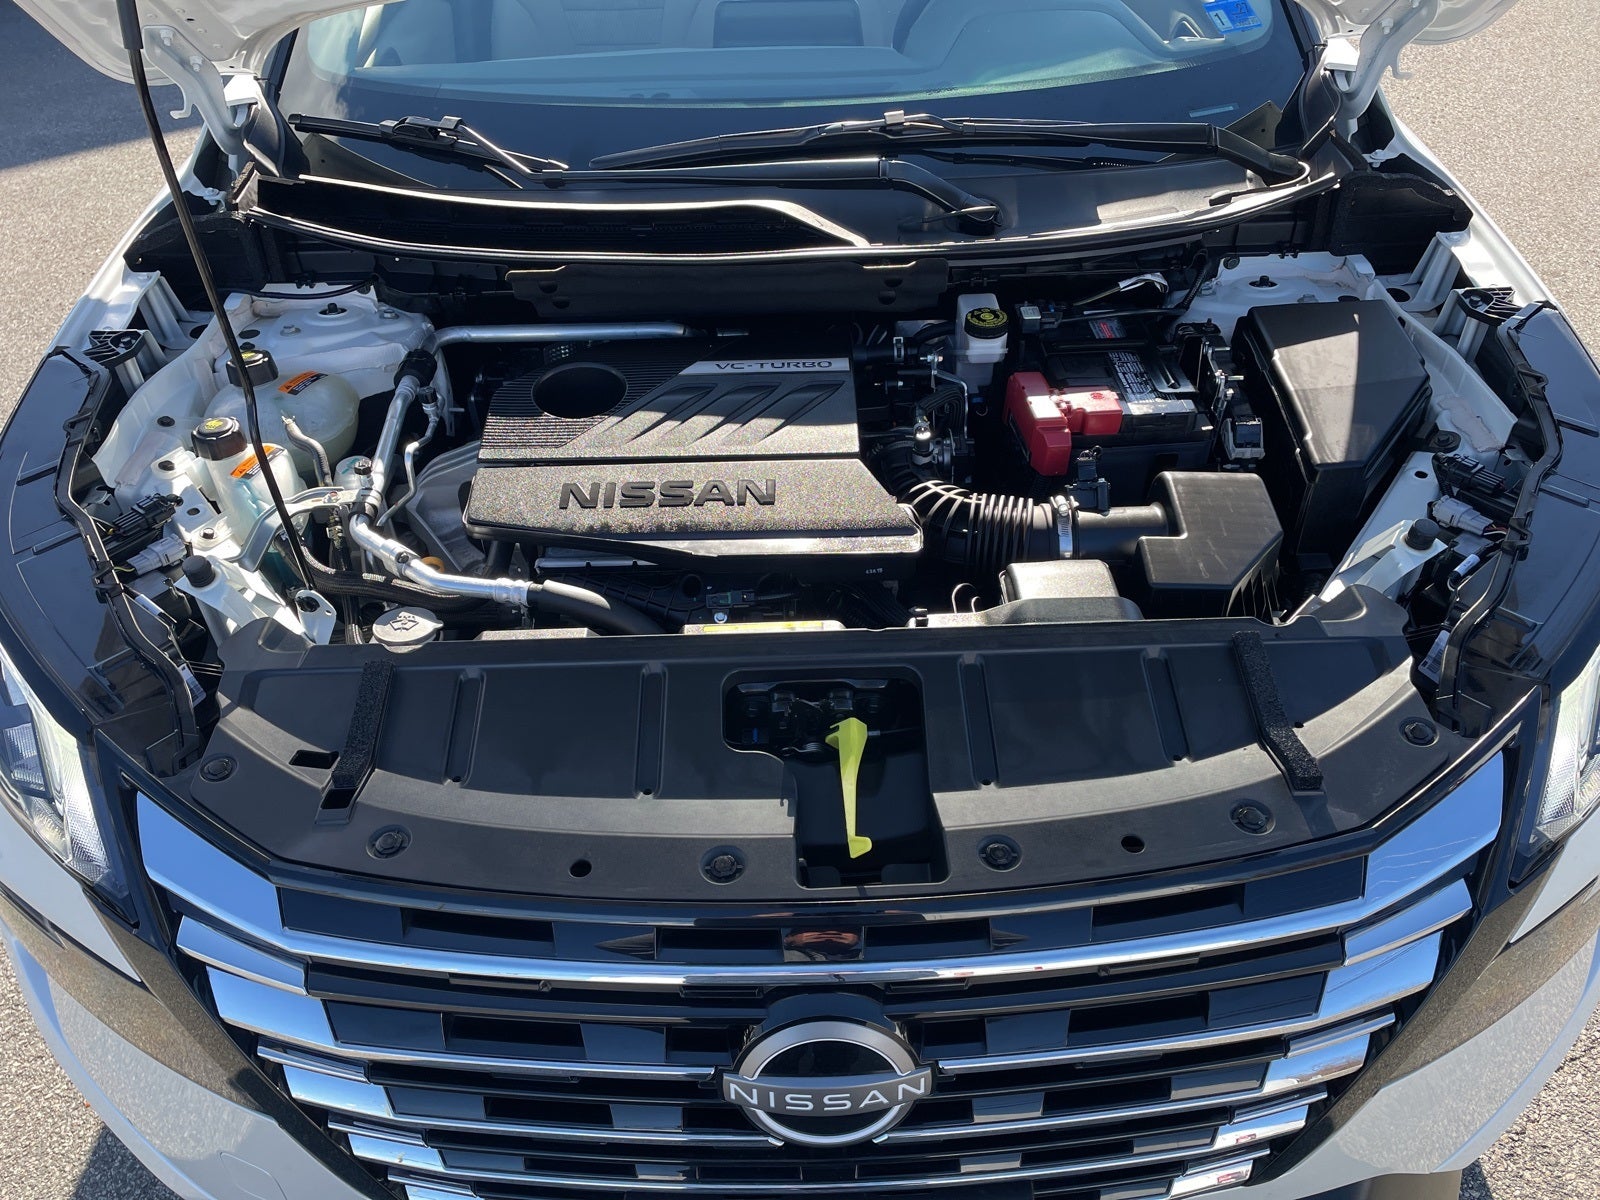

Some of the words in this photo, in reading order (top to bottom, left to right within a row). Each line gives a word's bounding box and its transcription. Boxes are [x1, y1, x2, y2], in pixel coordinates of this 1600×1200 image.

[1214, 12, 1225, 26] 1
[715, 360, 833, 370] VC-TURBO
[558, 478, 777, 509] NISSAN
[729, 1077, 926, 1112] NISSAN
